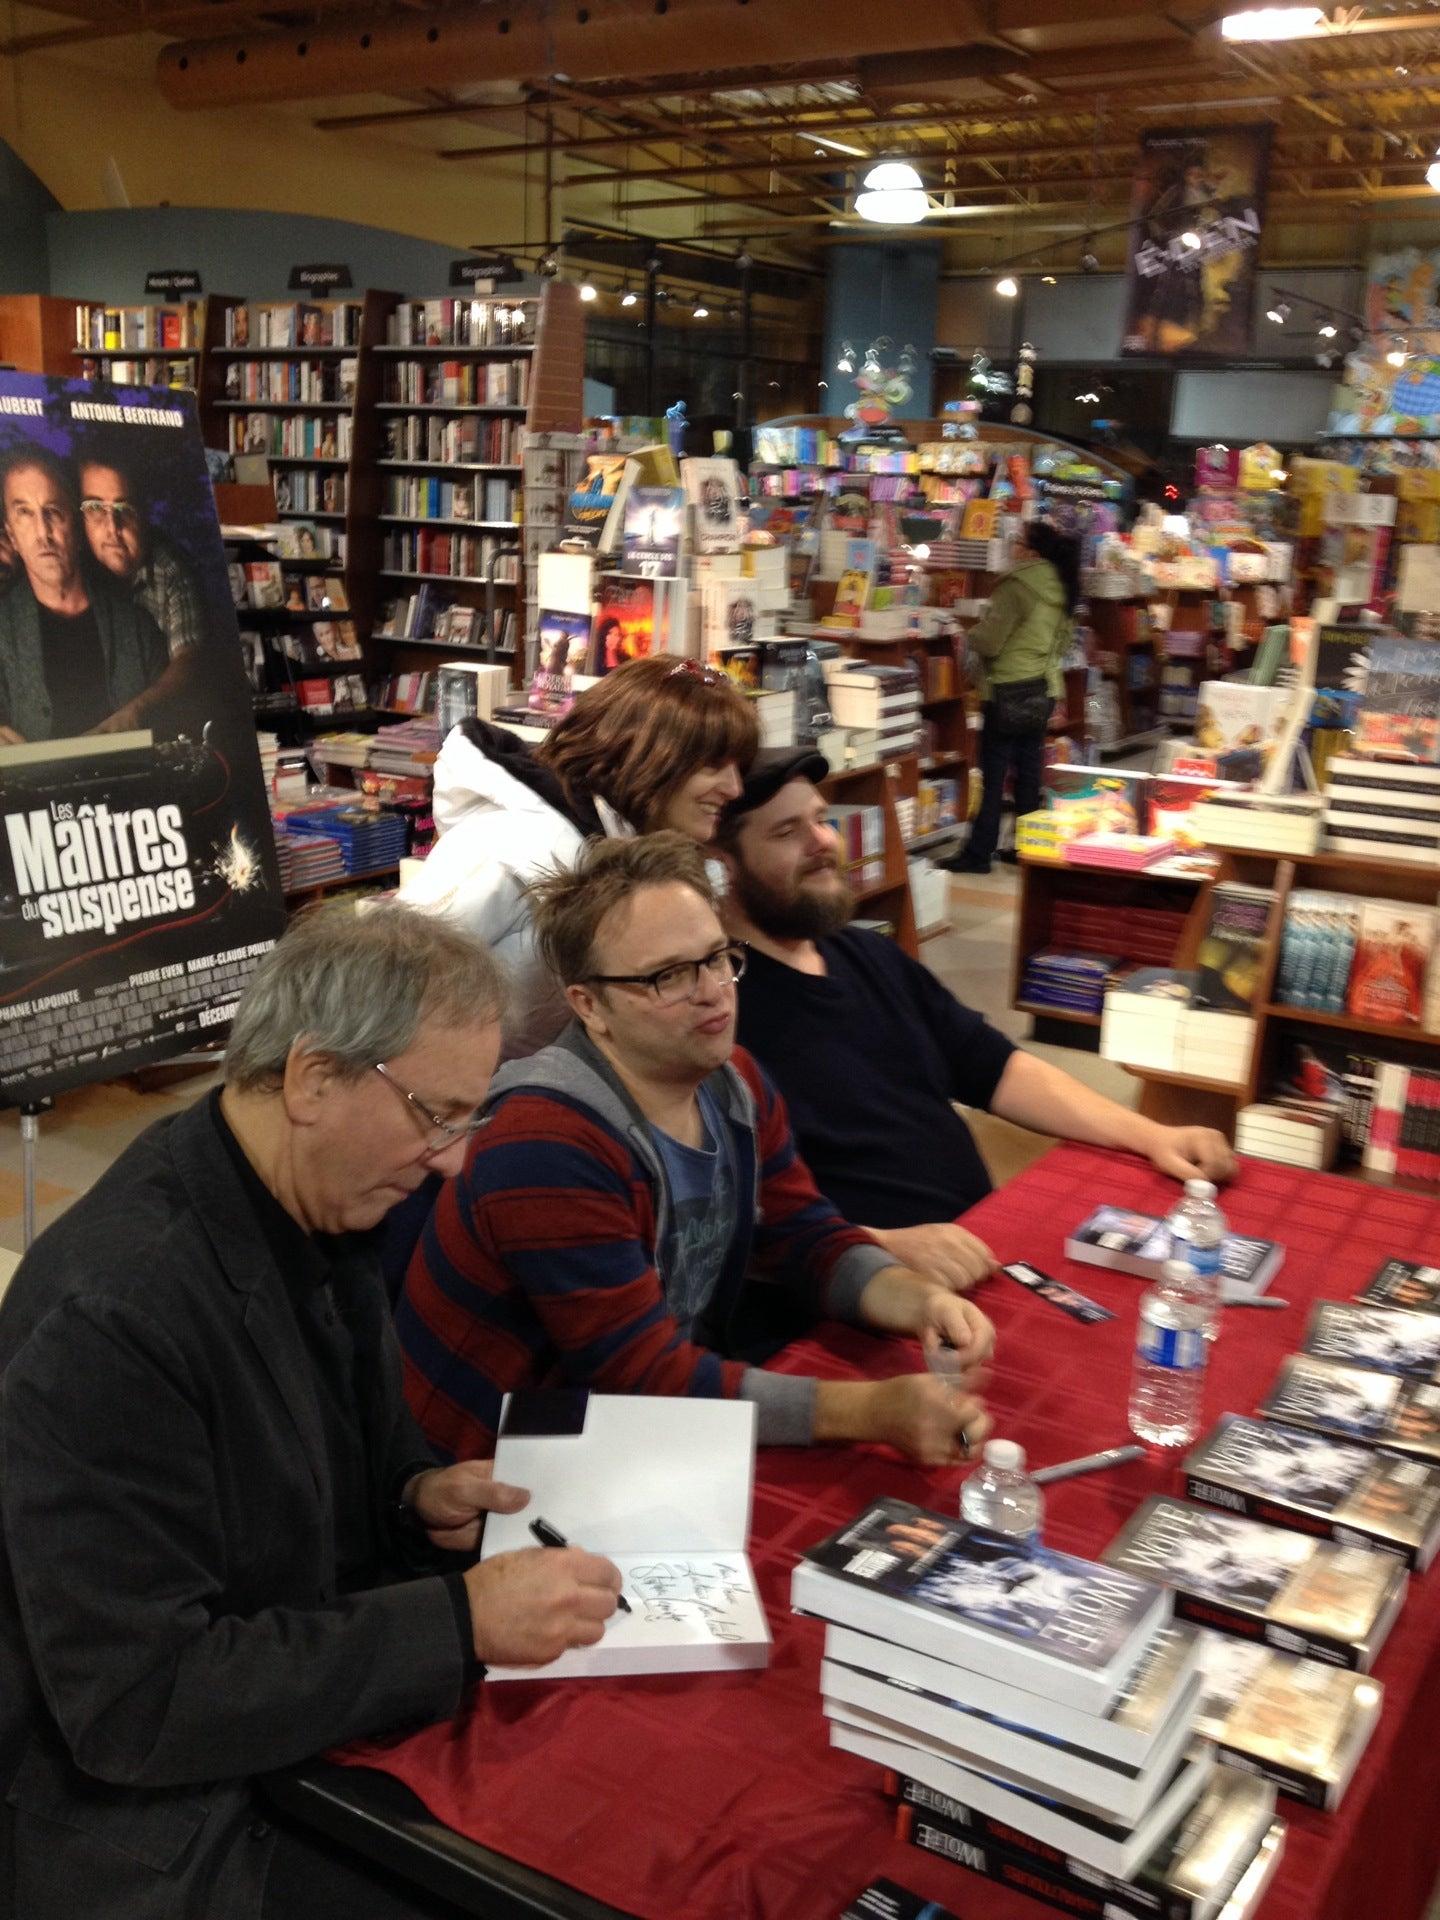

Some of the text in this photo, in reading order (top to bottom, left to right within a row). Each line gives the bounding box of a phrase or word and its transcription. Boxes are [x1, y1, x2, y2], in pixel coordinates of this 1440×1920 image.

[0, 396, 44, 417] UBERT
[70, 401, 184, 428] ANTOINE BERTRAND
[50, 800, 73, 822] Les
[4, 804, 189, 896] Maîtres
[21, 867, 196, 939] du suspense
[187, 946, 248, 973] MARIE-CLAUDE
[129, 963, 184, 987] PIERRE EVEN
[31, 989, 79, 1013] LAPOINTE
